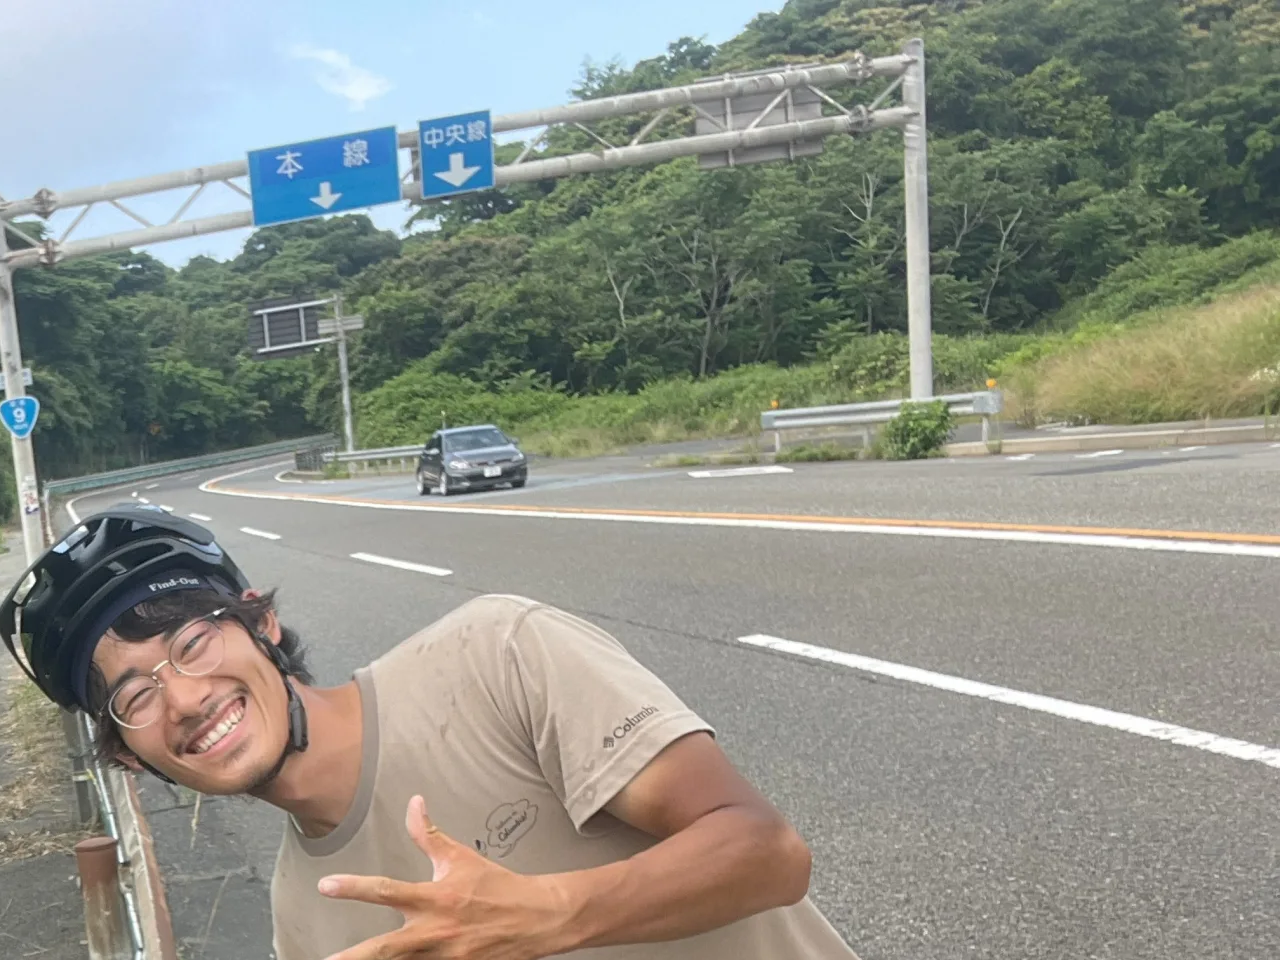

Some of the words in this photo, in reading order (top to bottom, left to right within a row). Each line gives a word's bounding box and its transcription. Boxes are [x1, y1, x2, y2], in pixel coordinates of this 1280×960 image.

[423, 119, 489, 149] 中央線
[12, 407, 26, 423] 9
[148, 577, 200, 592] Find-Out
